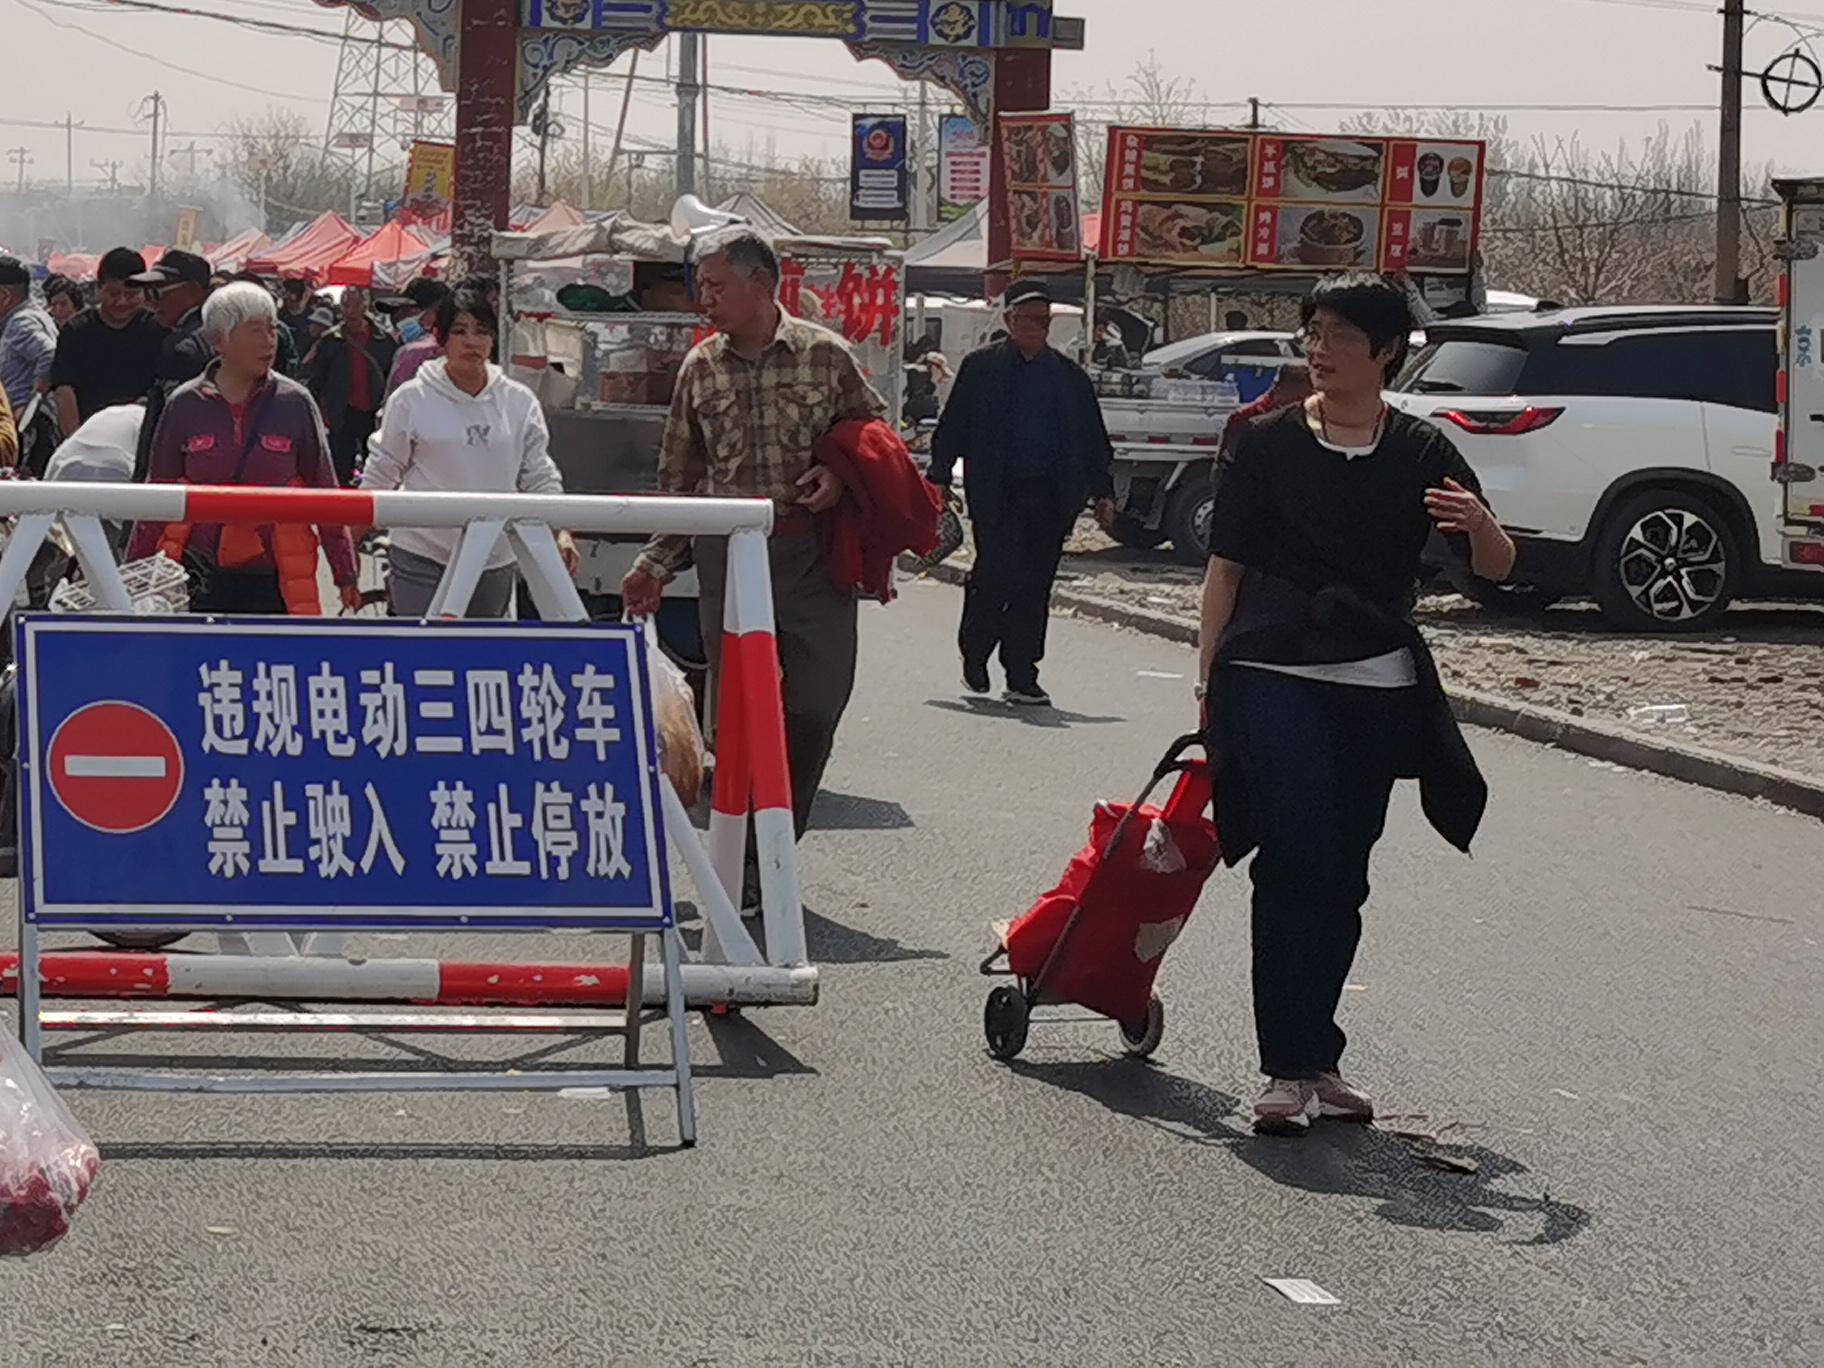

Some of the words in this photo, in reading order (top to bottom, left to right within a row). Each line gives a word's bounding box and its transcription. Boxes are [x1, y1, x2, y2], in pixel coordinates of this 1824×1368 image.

[198, 658, 622, 762] 违规电动三四轮车
[203, 778, 406, 879] 禁止驶入
[430, 781, 631, 881] 禁止停放
